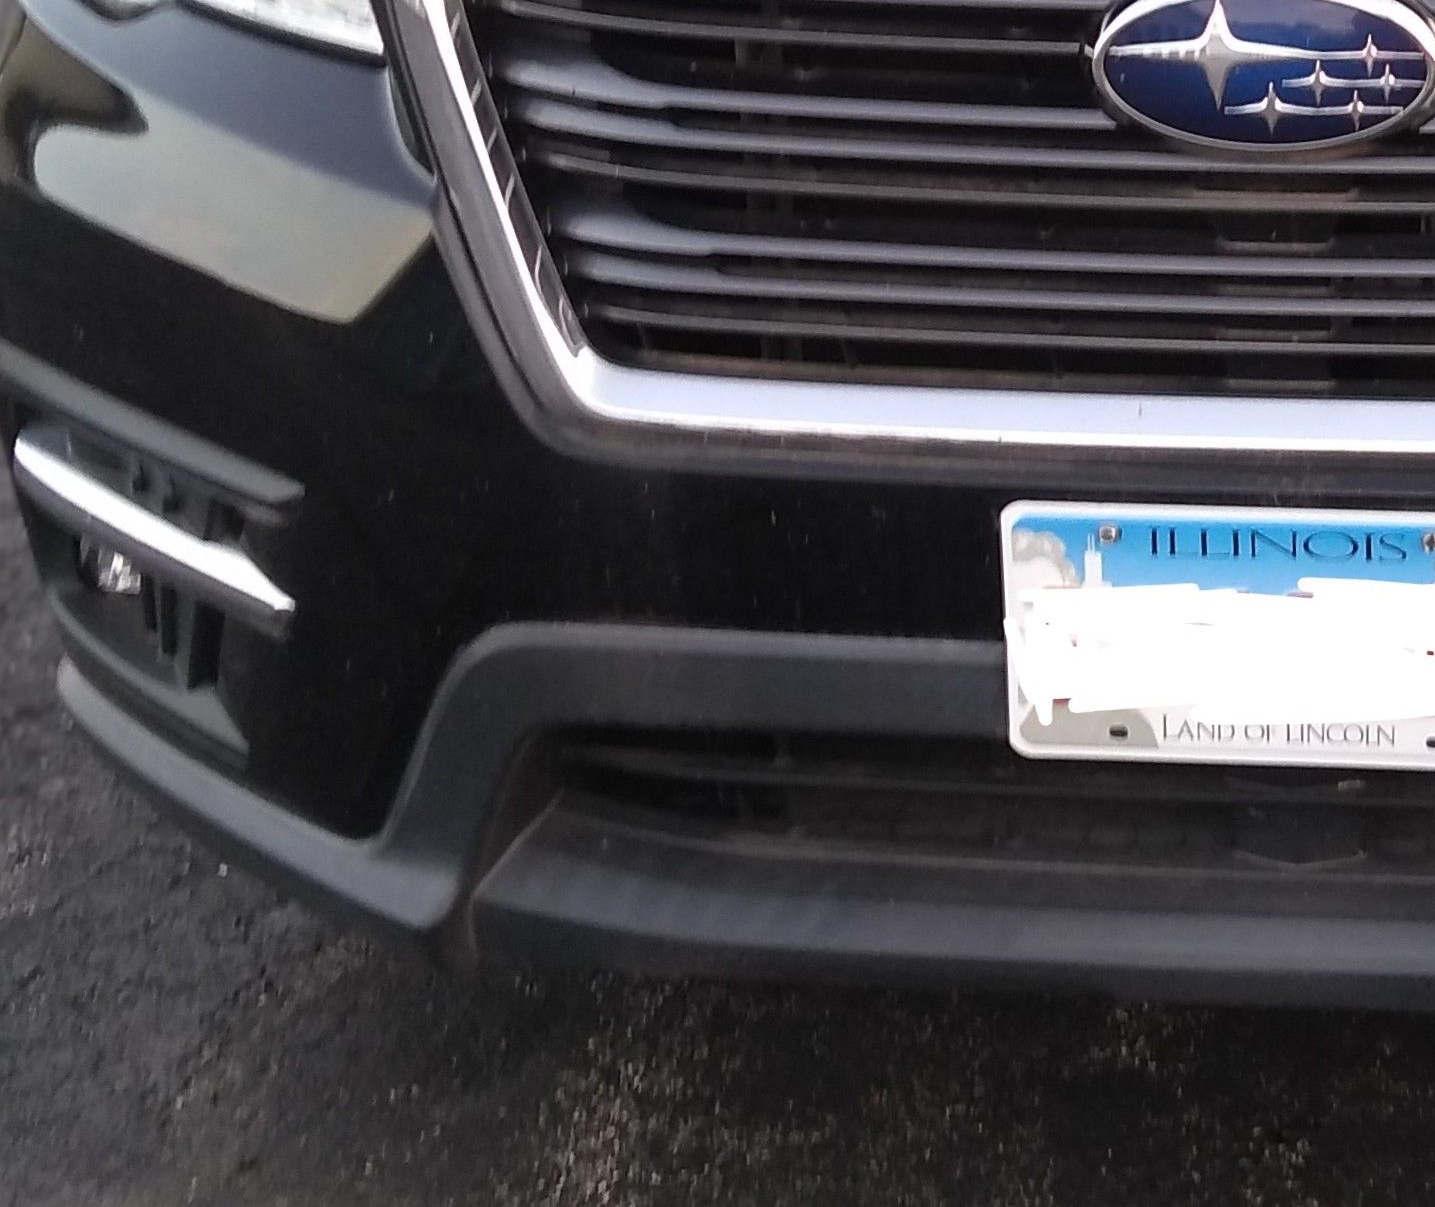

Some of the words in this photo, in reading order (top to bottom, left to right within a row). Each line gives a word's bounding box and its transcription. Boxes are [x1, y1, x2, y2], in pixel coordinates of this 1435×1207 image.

[1149, 526, 1408, 562] ILLINOIS
[1163, 713, 1235, 742] LAND
[1286, 723, 1396, 748] LINCOLN
